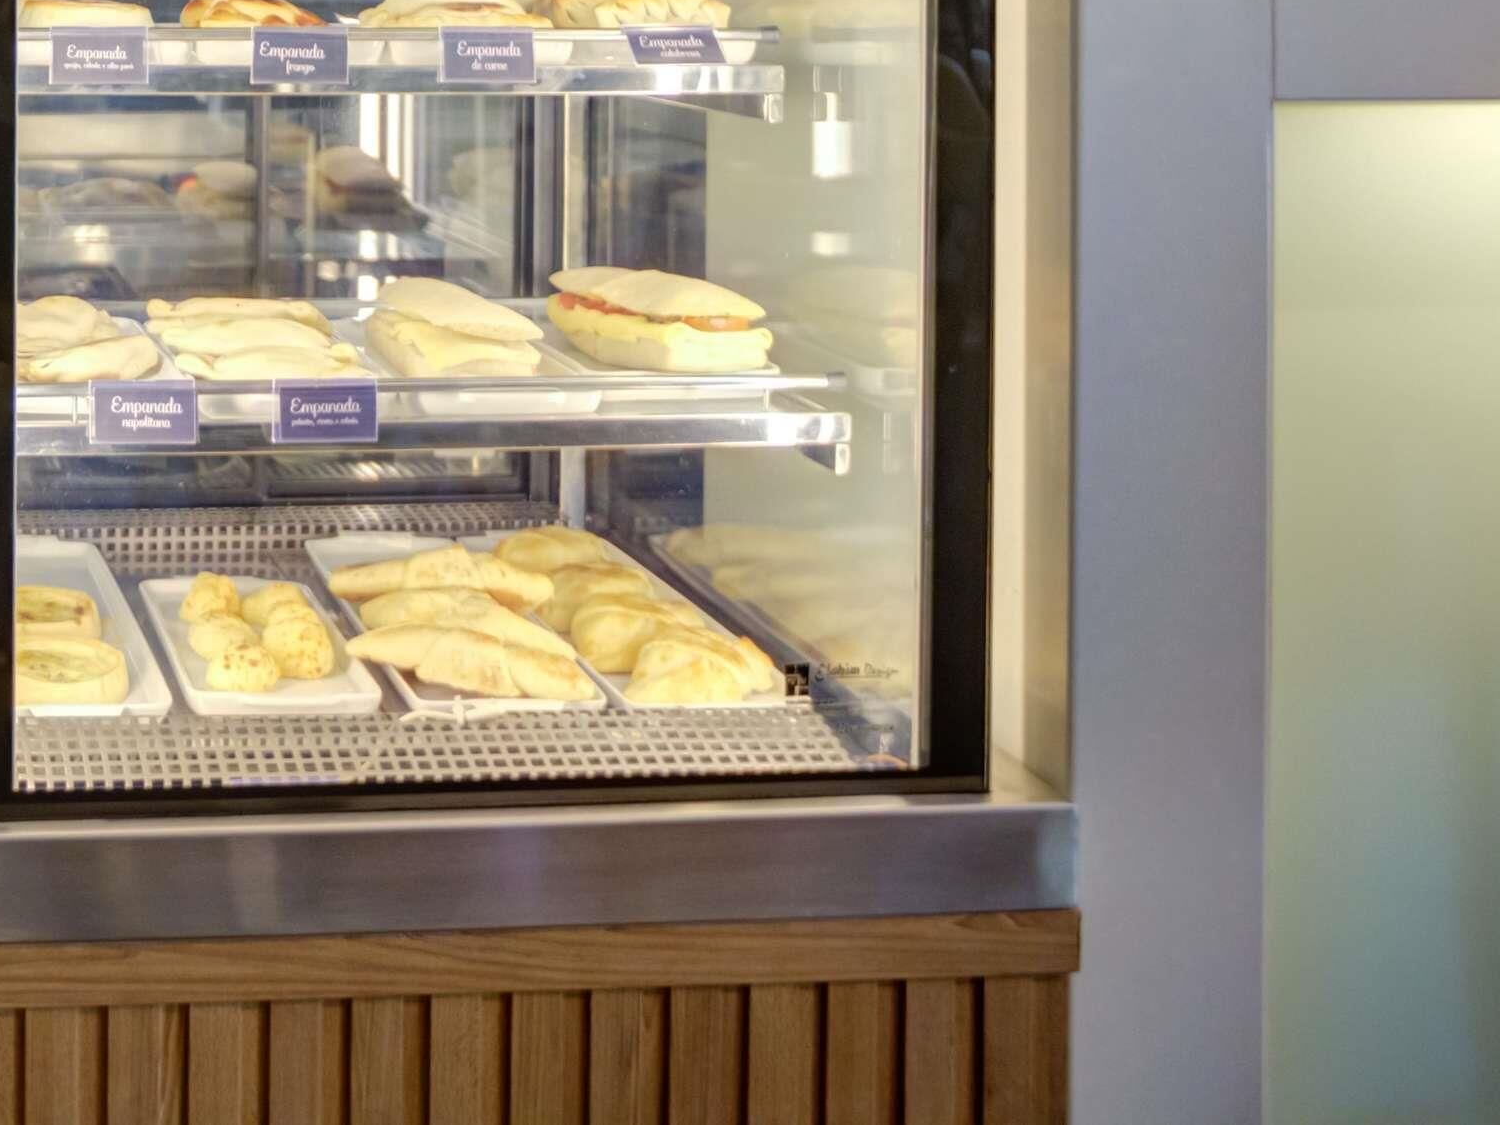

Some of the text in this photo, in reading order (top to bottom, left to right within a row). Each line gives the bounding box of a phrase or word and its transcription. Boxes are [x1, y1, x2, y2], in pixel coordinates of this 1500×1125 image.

[66, 42, 128, 62] Empanada
[259, 40, 327, 63] Empanada
[456, 39, 523, 61] Empanada
[638, 34, 706, 51] Empanada
[110, 395, 184, 418] Empanada
[290, 395, 363, 418] Empanada
[121, 415, 173, 432] napolitana
